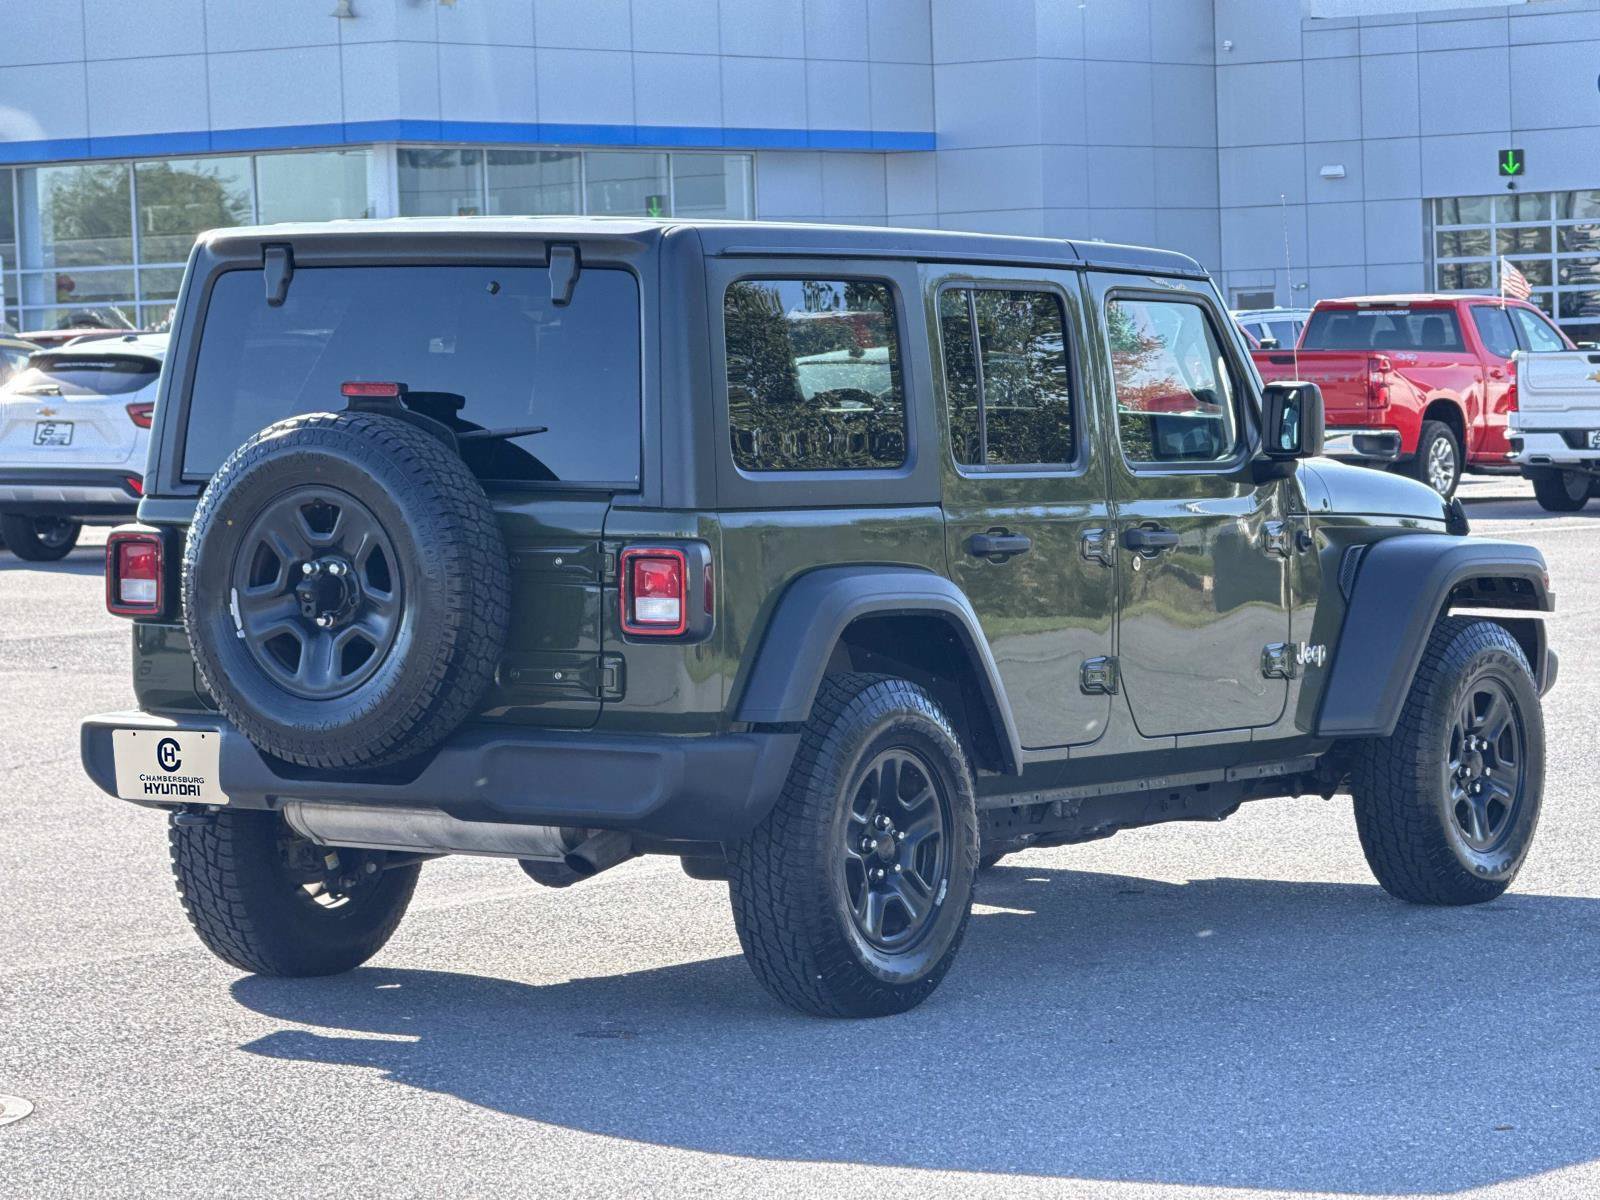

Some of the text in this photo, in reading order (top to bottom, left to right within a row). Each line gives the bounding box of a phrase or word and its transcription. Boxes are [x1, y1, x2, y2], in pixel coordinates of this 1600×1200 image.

[1296, 641, 1327, 668] Jeep
[139, 773, 205, 784] CHAMBERSBURG
[144, 782, 201, 797] HYUNDAI
